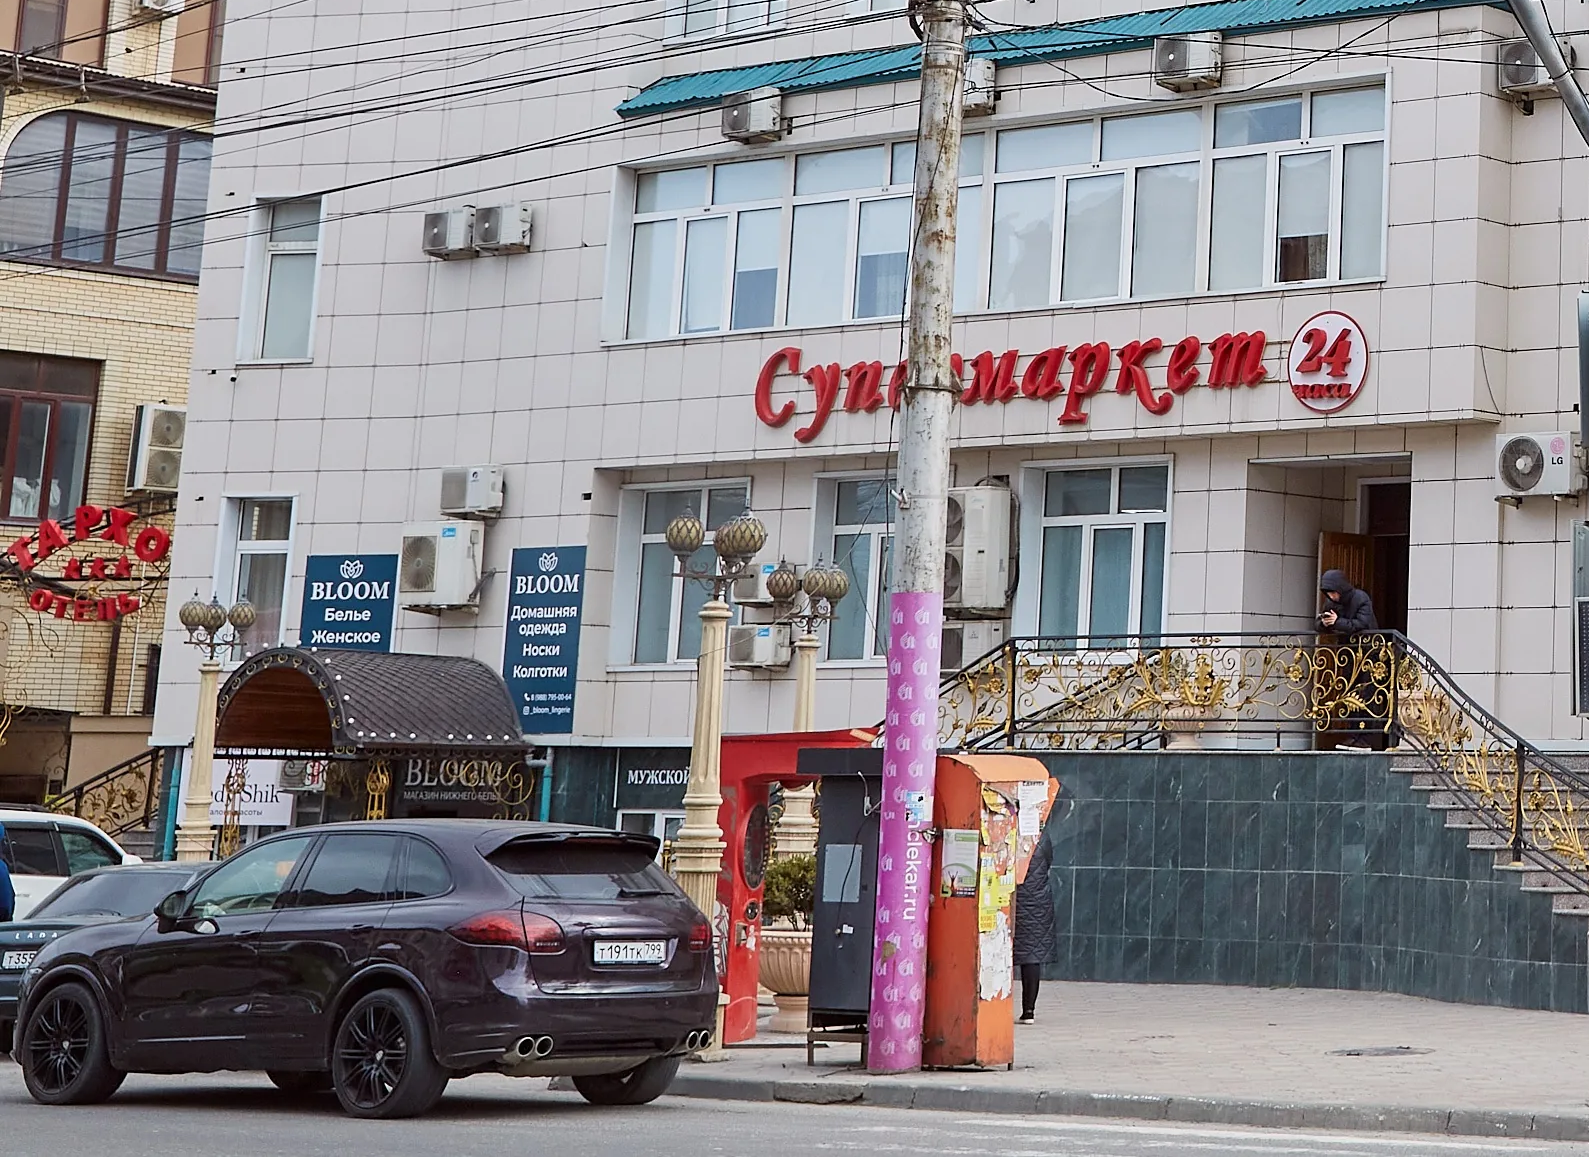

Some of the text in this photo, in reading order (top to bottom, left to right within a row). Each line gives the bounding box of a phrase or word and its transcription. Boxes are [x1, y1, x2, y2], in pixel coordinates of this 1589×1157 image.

[1296, 328, 1352, 377] 24
[1551, 456, 1563, 465] LG
[7, 504, 171, 572] ТАРХО
[311, 581, 390, 600] BLOOM
[515, 574, 580, 595] BLOOM
[324, 607, 372, 622] Белье
[510, 605, 578, 622] Домашняя
[311, 629, 381, 644] Женское
[518, 623, 567, 637] одежда
[522, 643, 560, 657] Носки
[513, 665, 568, 678] Колготки
[405, 759, 502, 787] BLOOM
[404, 790, 499, 801] МАГАЗИН НИЖНЕГО БЕЛЬ
[15, 932, 58, 940] LADA
[645, 943, 662, 955] 799
